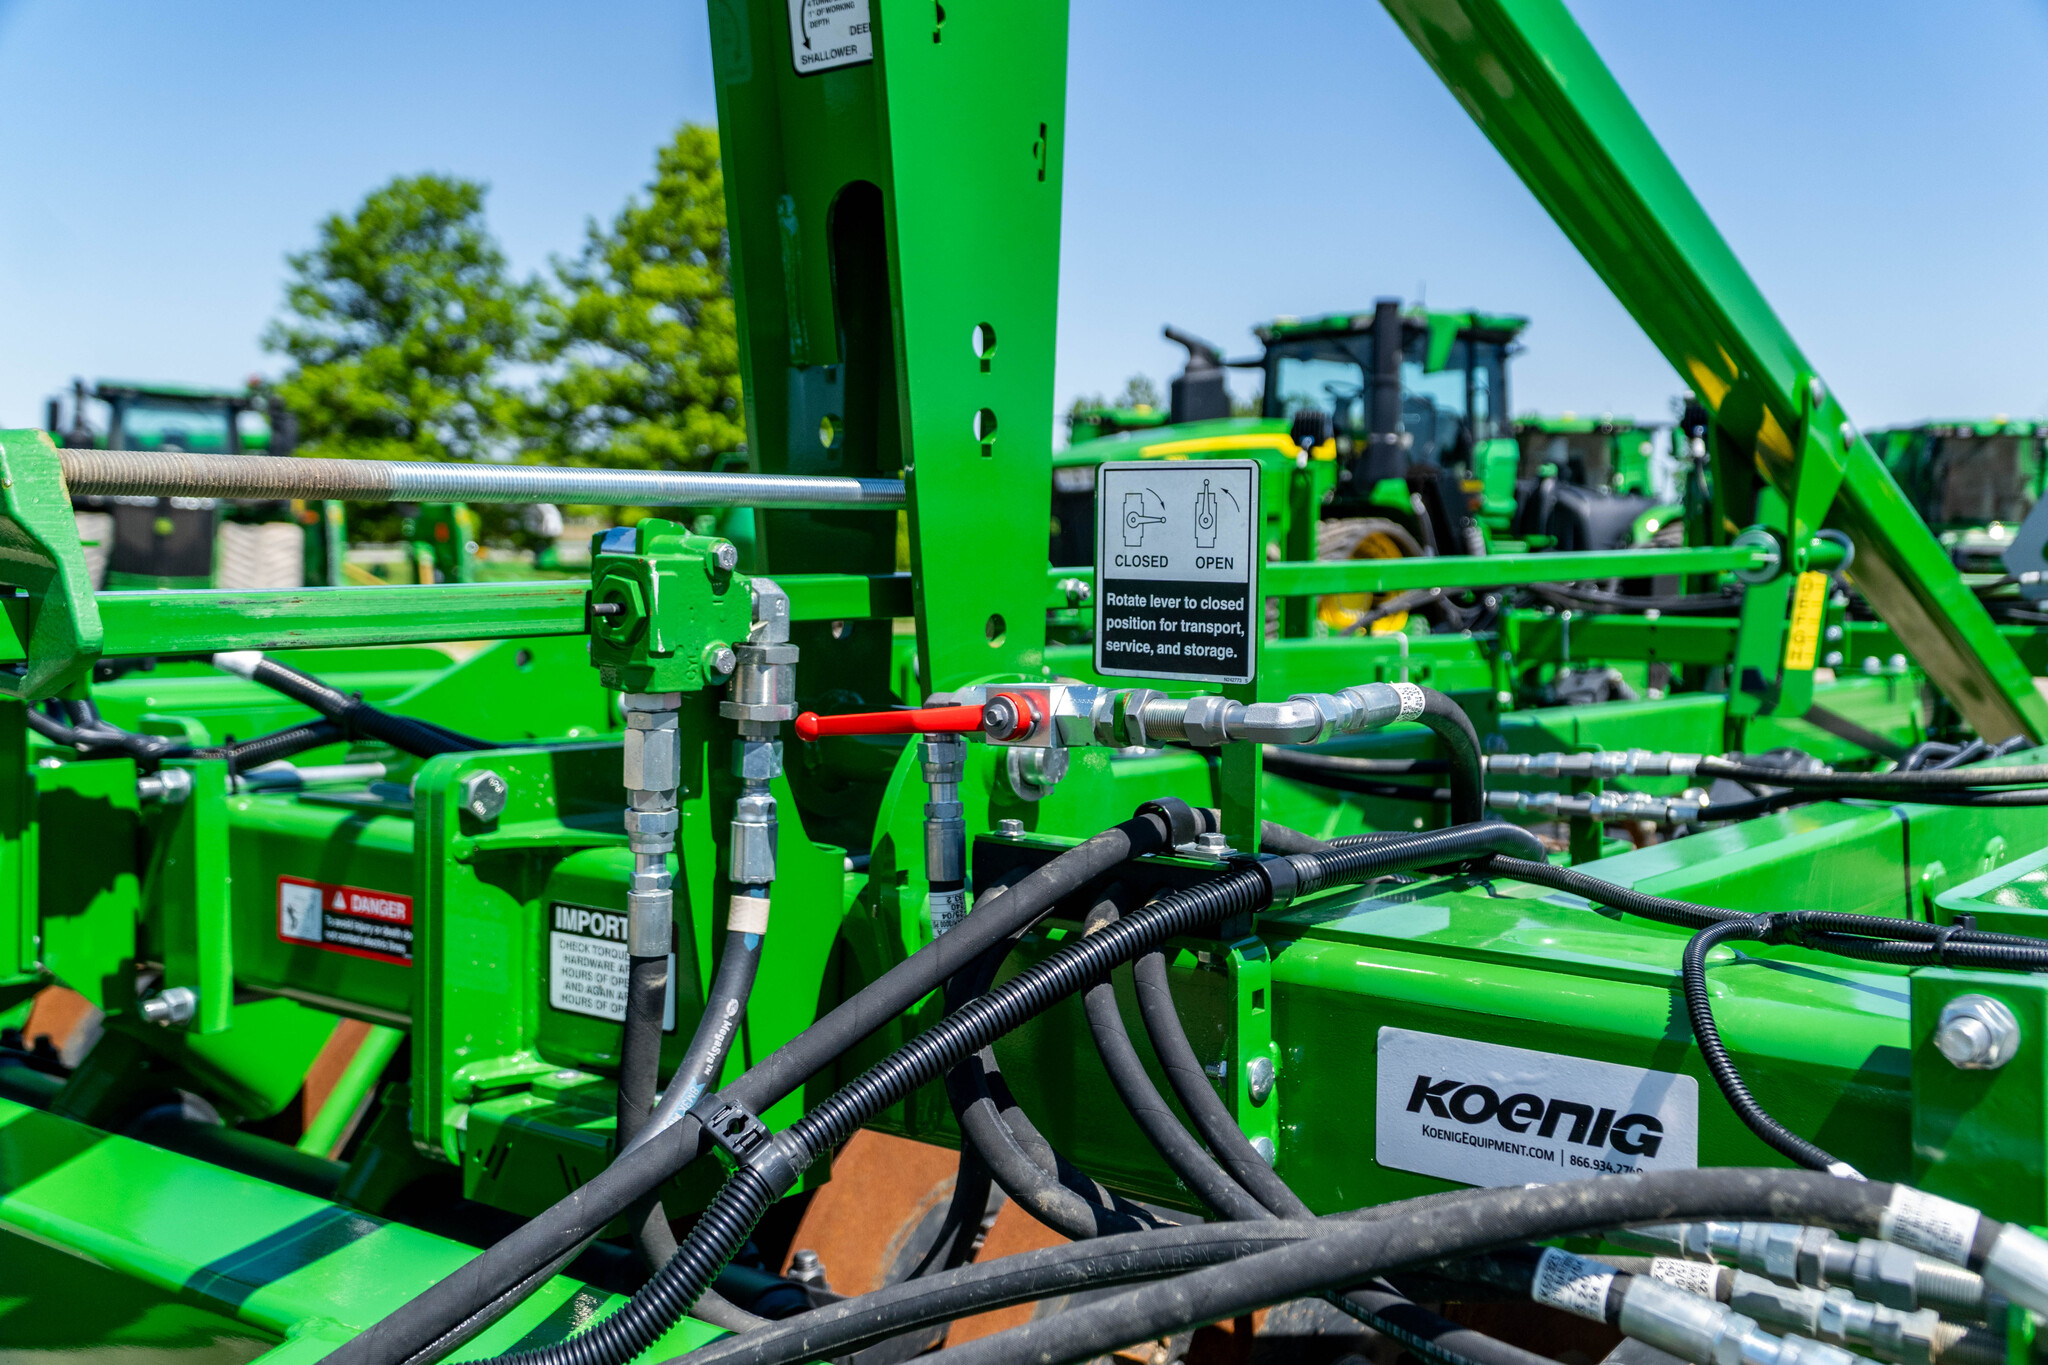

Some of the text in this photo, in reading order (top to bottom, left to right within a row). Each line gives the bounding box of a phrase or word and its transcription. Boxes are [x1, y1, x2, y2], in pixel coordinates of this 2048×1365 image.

[825, 1, 855, 14] WORKING
[810, 17, 830, 29] DEPTH
[801, 45, 858, 65] SHALLOWER
[1114, 554, 1169, 568] CLOSED
[1195, 556, 1234, 570] OPEN
[1106, 592, 1244, 611] Rotate lever to closed
[1106, 616, 1245, 638] position for transport,
[1106, 639, 1238, 661] service, and storage.
[351, 894, 406, 920] DANGER
[560, 939, 590, 954] CHECK
[564, 954, 616, 972] HARDWARE
[562, 967, 593, 982] HOURS
[596, 972, 608, 983] OF
[565, 981, 584, 993] AND
[587, 985, 614, 999] AGAIN
[562, 994, 593, 1009] HOURS
[596, 1000, 608, 1010] OF
